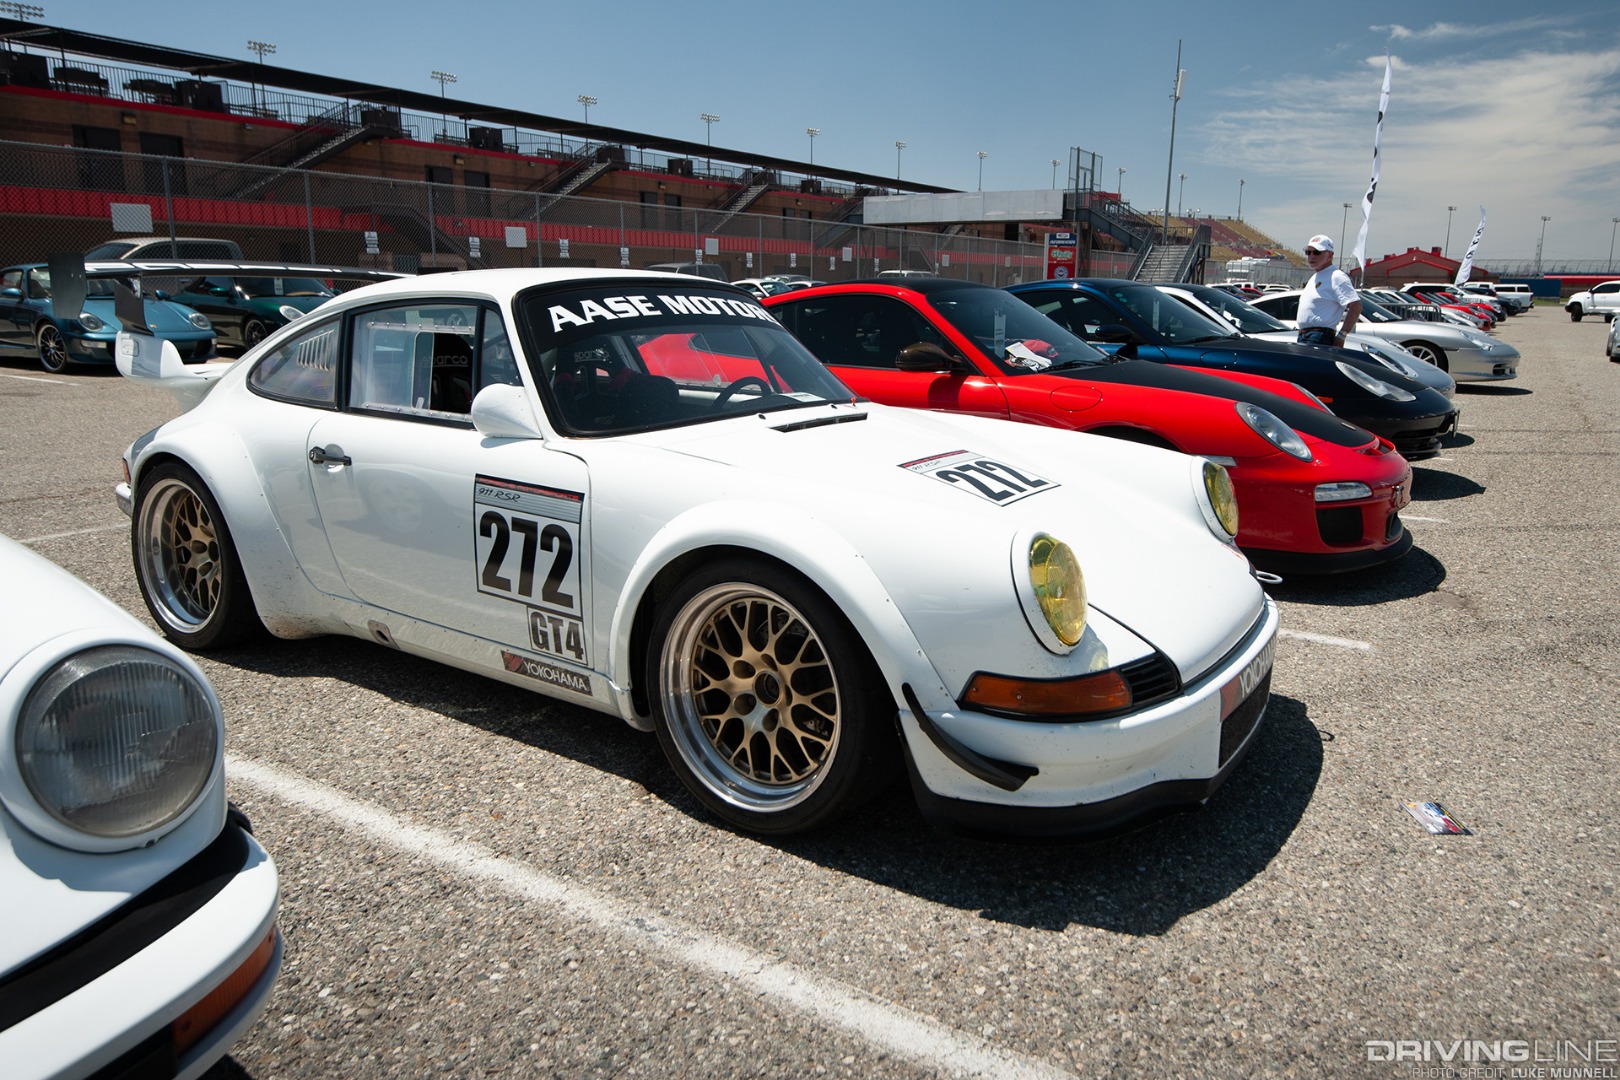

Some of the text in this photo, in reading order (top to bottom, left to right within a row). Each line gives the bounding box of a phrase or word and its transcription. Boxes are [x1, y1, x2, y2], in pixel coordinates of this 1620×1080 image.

[548, 295, 662, 333] AASE
[575, 350, 610, 361] sparo
[478, 487, 494, 497] 911
[494, 490, 521, 503] RSR
[936, 460, 1050, 502] 272
[480, 510, 573, 609] 272
[530, 611, 584, 660] GT4
[524, 660, 588, 691] YOKOHAMA
